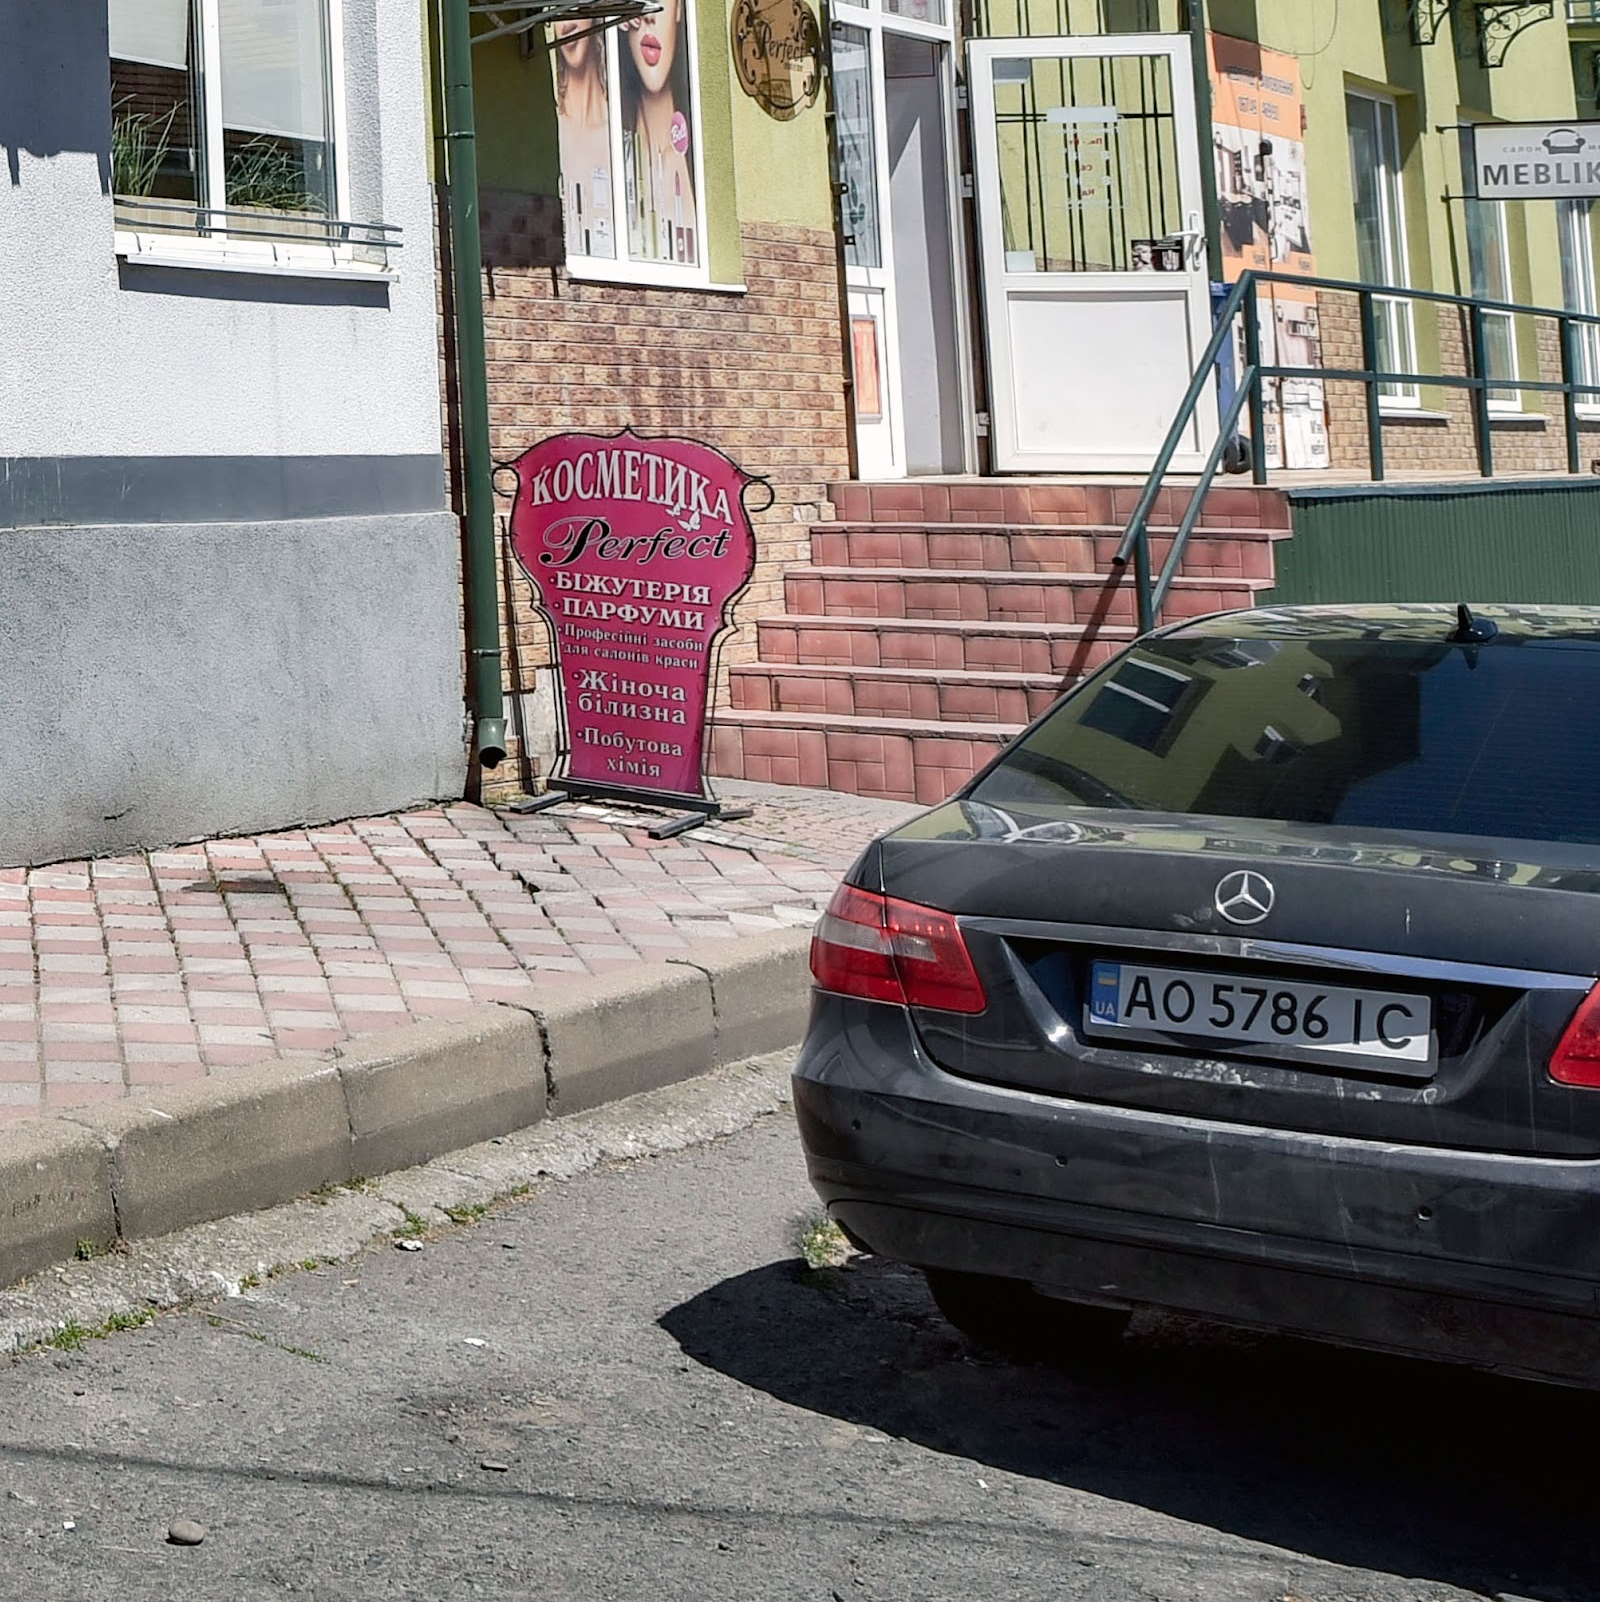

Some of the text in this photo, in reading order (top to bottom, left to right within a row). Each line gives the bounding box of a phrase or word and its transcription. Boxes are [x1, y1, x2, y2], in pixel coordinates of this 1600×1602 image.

[753, 20, 805, 63] Perfect
[530, 448, 735, 526] КОСМЕТИКА
[538, 515, 733, 569] Perfect
[556, 570, 711, 605] БІЖУТЕРІЯ
[562, 597, 705, 631] ПАРФУМИ
[564, 623, 704, 652] Професійні засоби
[564, 643, 698, 669] для салонів краси
[578, 669, 687, 702] Жіноча
[577, 694, 687, 726] білизна
[584, 727, 683, 757] Побутова
[606, 755, 661, 778] хімія
[1096, 1001, 1116, 1017] UA
[1208, 983, 1329, 1039] 5786
